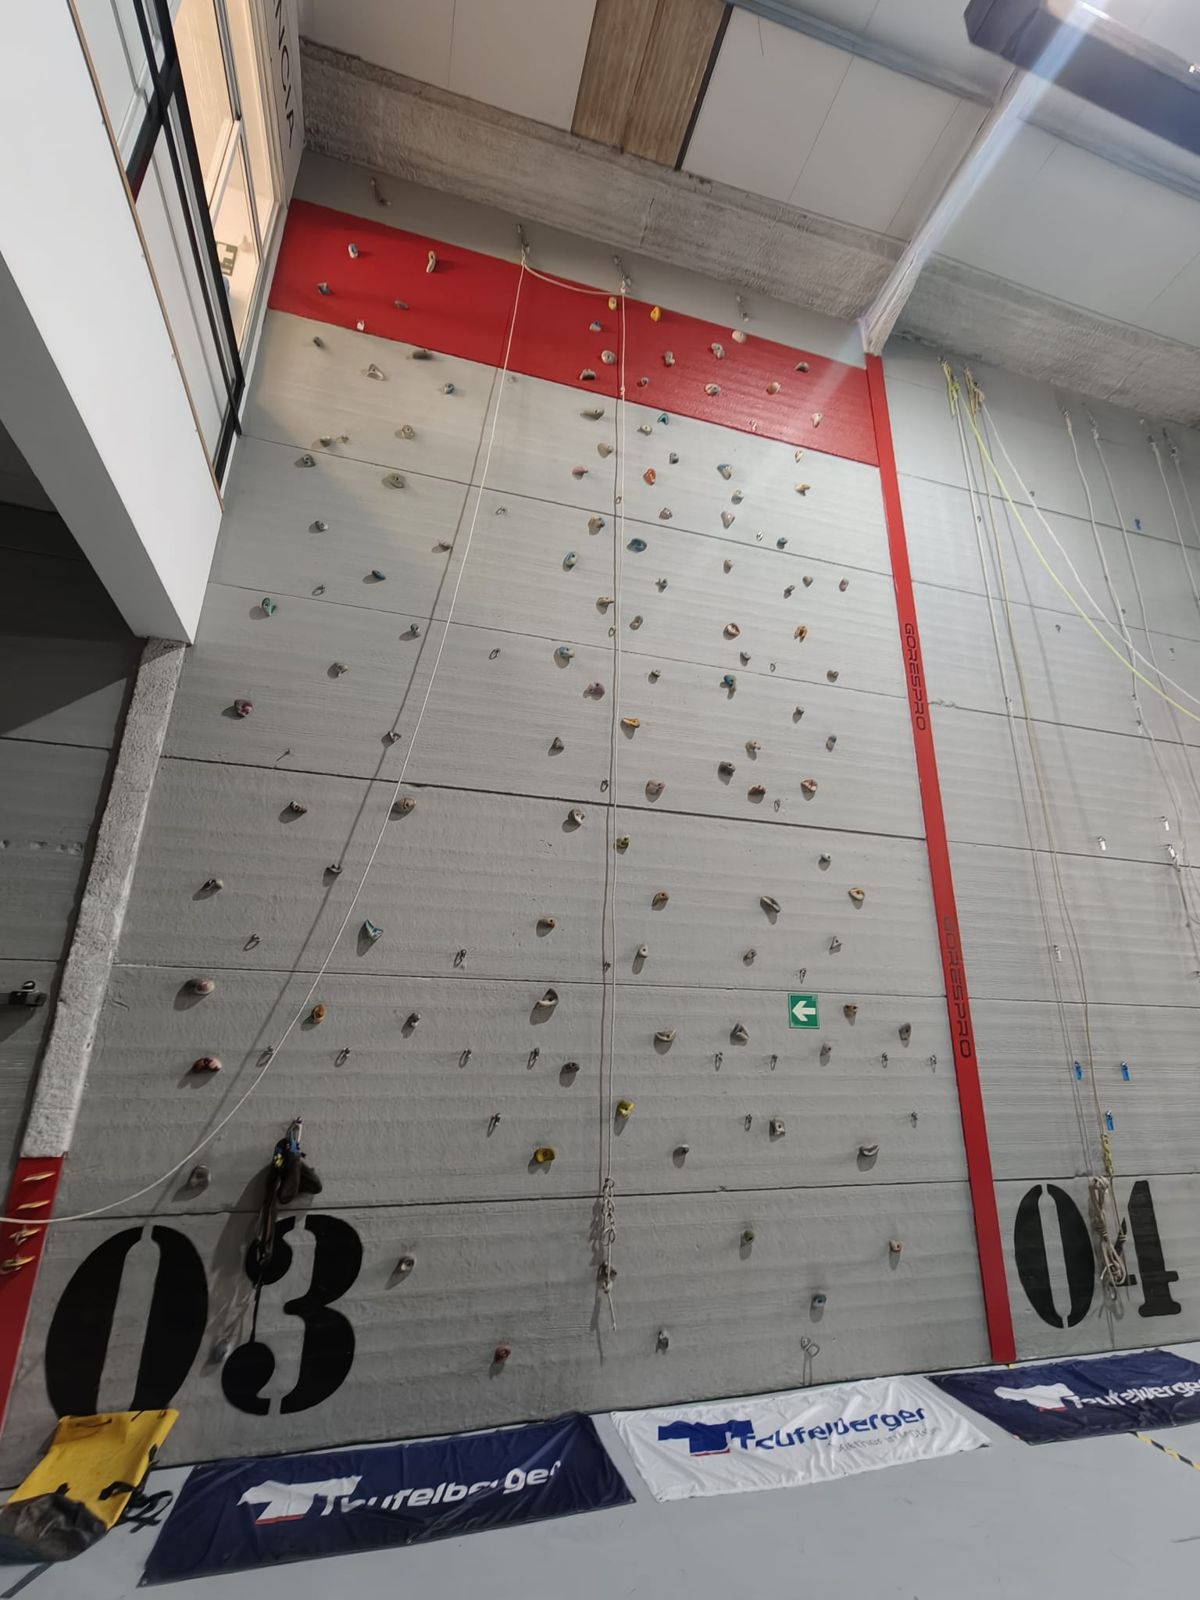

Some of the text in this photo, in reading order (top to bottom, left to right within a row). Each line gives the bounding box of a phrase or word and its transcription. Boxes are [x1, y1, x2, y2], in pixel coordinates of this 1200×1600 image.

[272, 0, 295, 150] NCIA
[904, 622, 927, 731] GORESPRO
[44, 1213, 364, 1416] 03
[1013, 1179, 1182, 1329] 04
